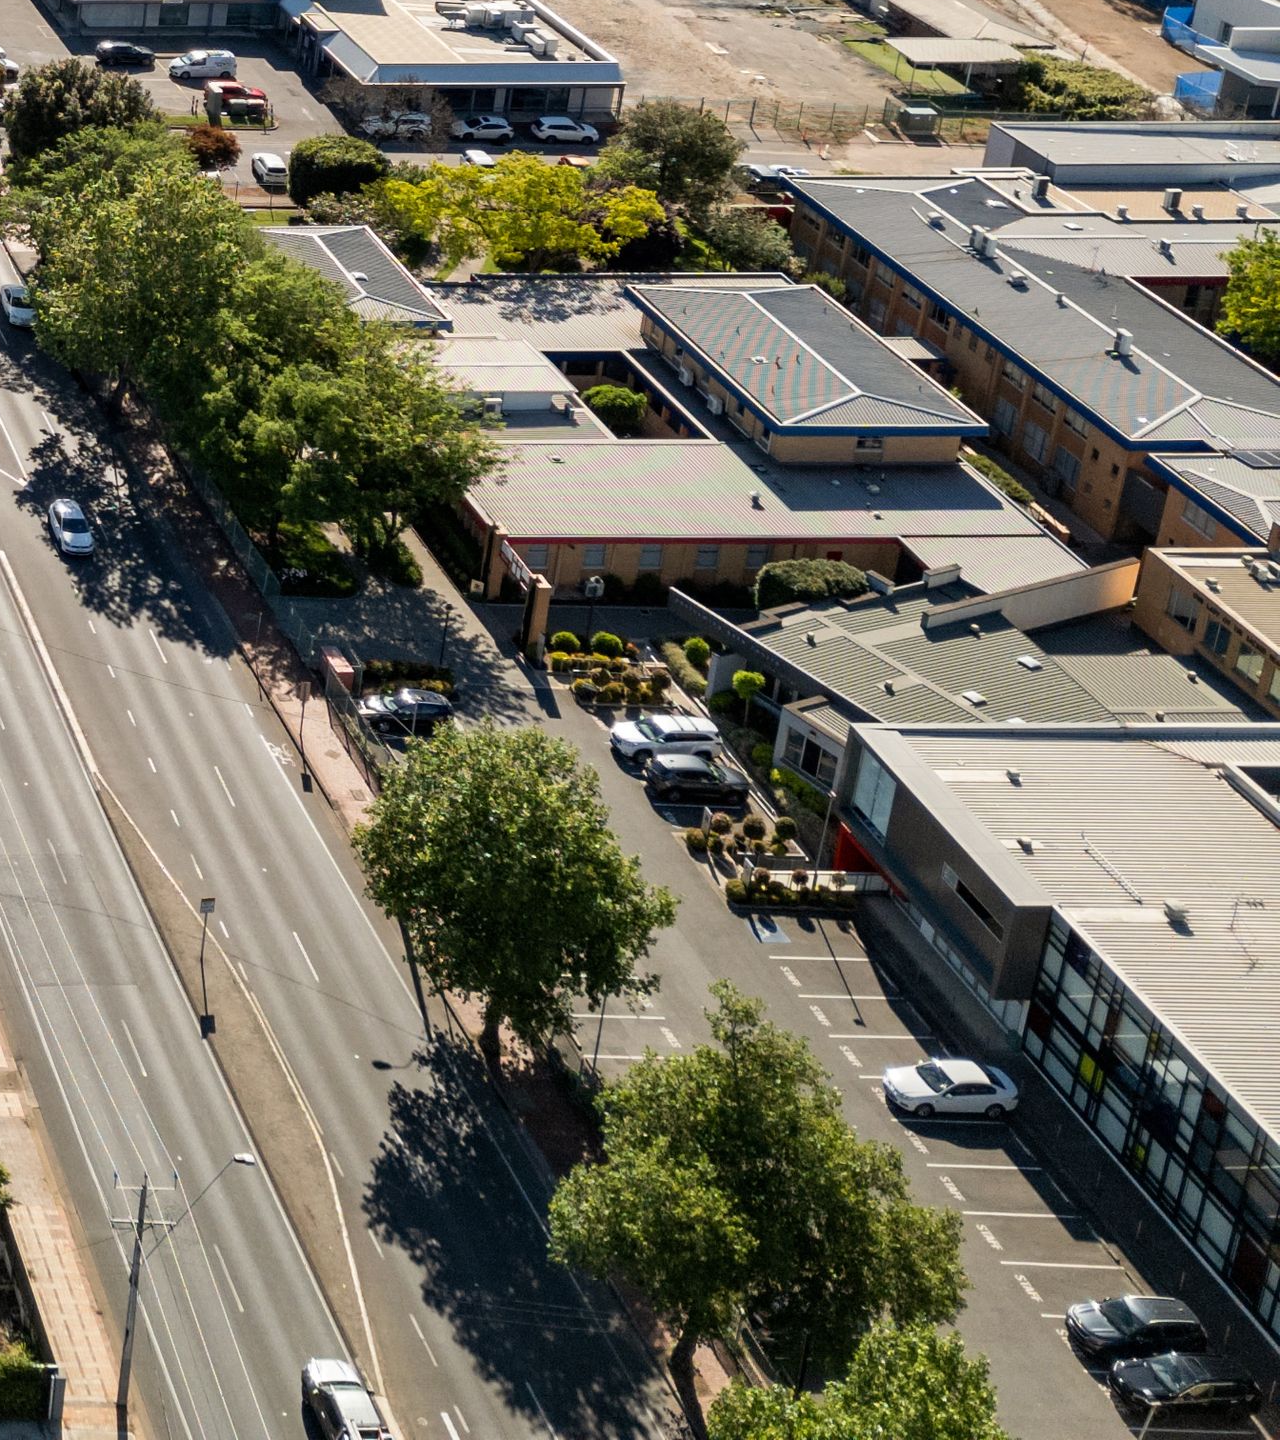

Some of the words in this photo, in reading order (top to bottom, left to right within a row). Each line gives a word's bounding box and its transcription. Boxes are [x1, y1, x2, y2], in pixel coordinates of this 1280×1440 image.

[939, 1175, 967, 1202] STAFF
[976, 1223, 1004, 1251] STAFF
[1014, 1273, 1044, 1304] STAFF
